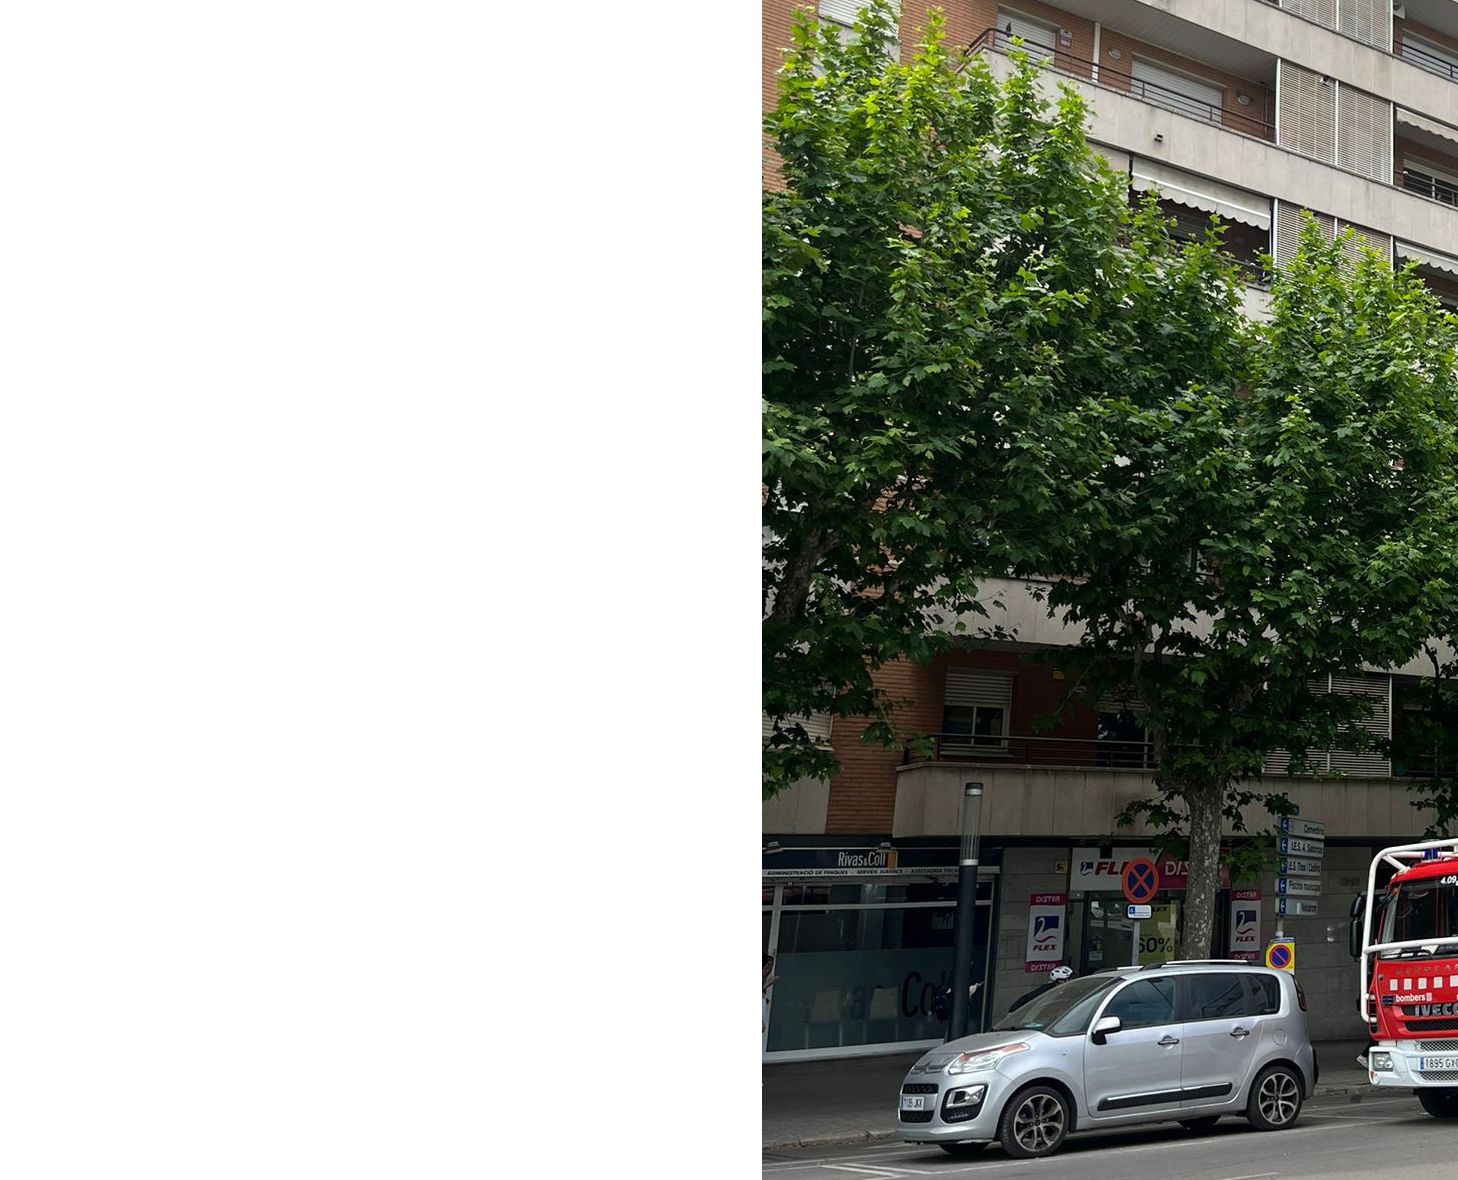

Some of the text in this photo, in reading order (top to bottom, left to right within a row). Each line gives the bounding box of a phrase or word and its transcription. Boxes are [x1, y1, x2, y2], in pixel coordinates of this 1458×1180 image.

[1095, 861, 1128, 875] FL
[1395, 993, 1425, 1003] bombers
[1425, 1058, 1443, 1068] 1895
